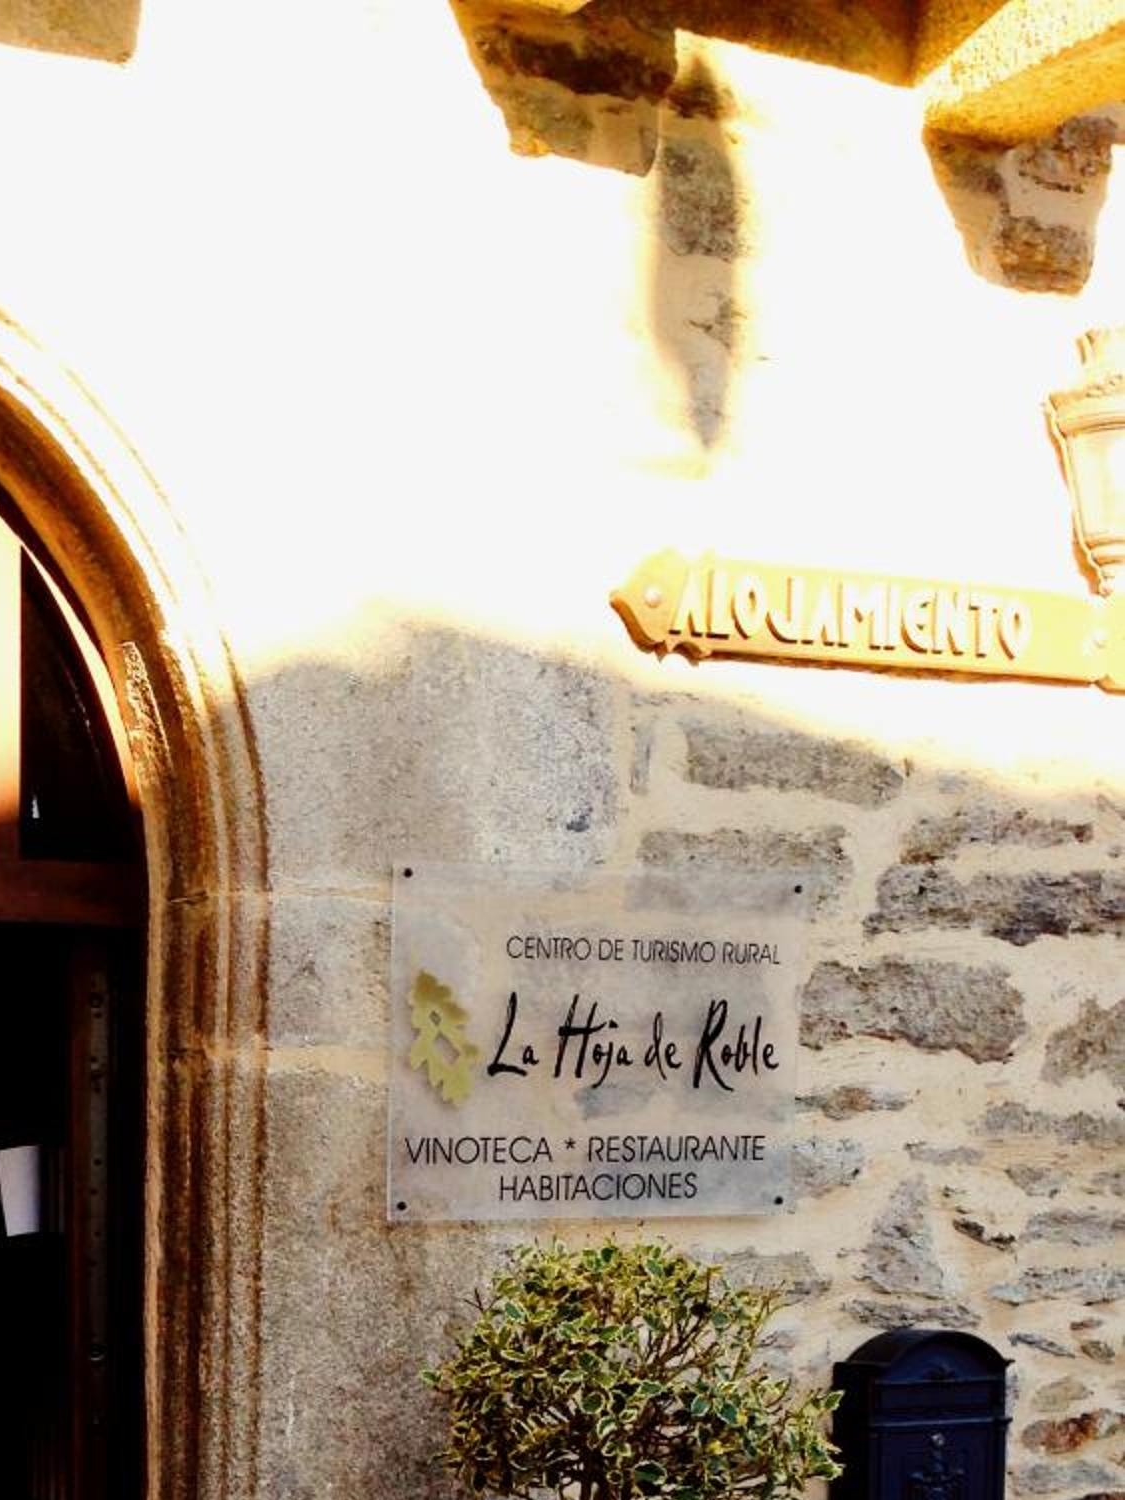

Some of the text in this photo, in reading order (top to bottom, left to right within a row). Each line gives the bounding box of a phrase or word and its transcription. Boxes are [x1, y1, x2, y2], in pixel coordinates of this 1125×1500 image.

[667, 565, 1033, 660] ALOJAMIENTO
[506, 934, 780, 966] CENTRO DE TURISMO RURAL
[487, 991, 780, 1092] La Hoja de Roble
[405, 1135, 766, 1165] VINOTECA RESTAURANTE
[499, 1172, 698, 1201] HABITACIONES
